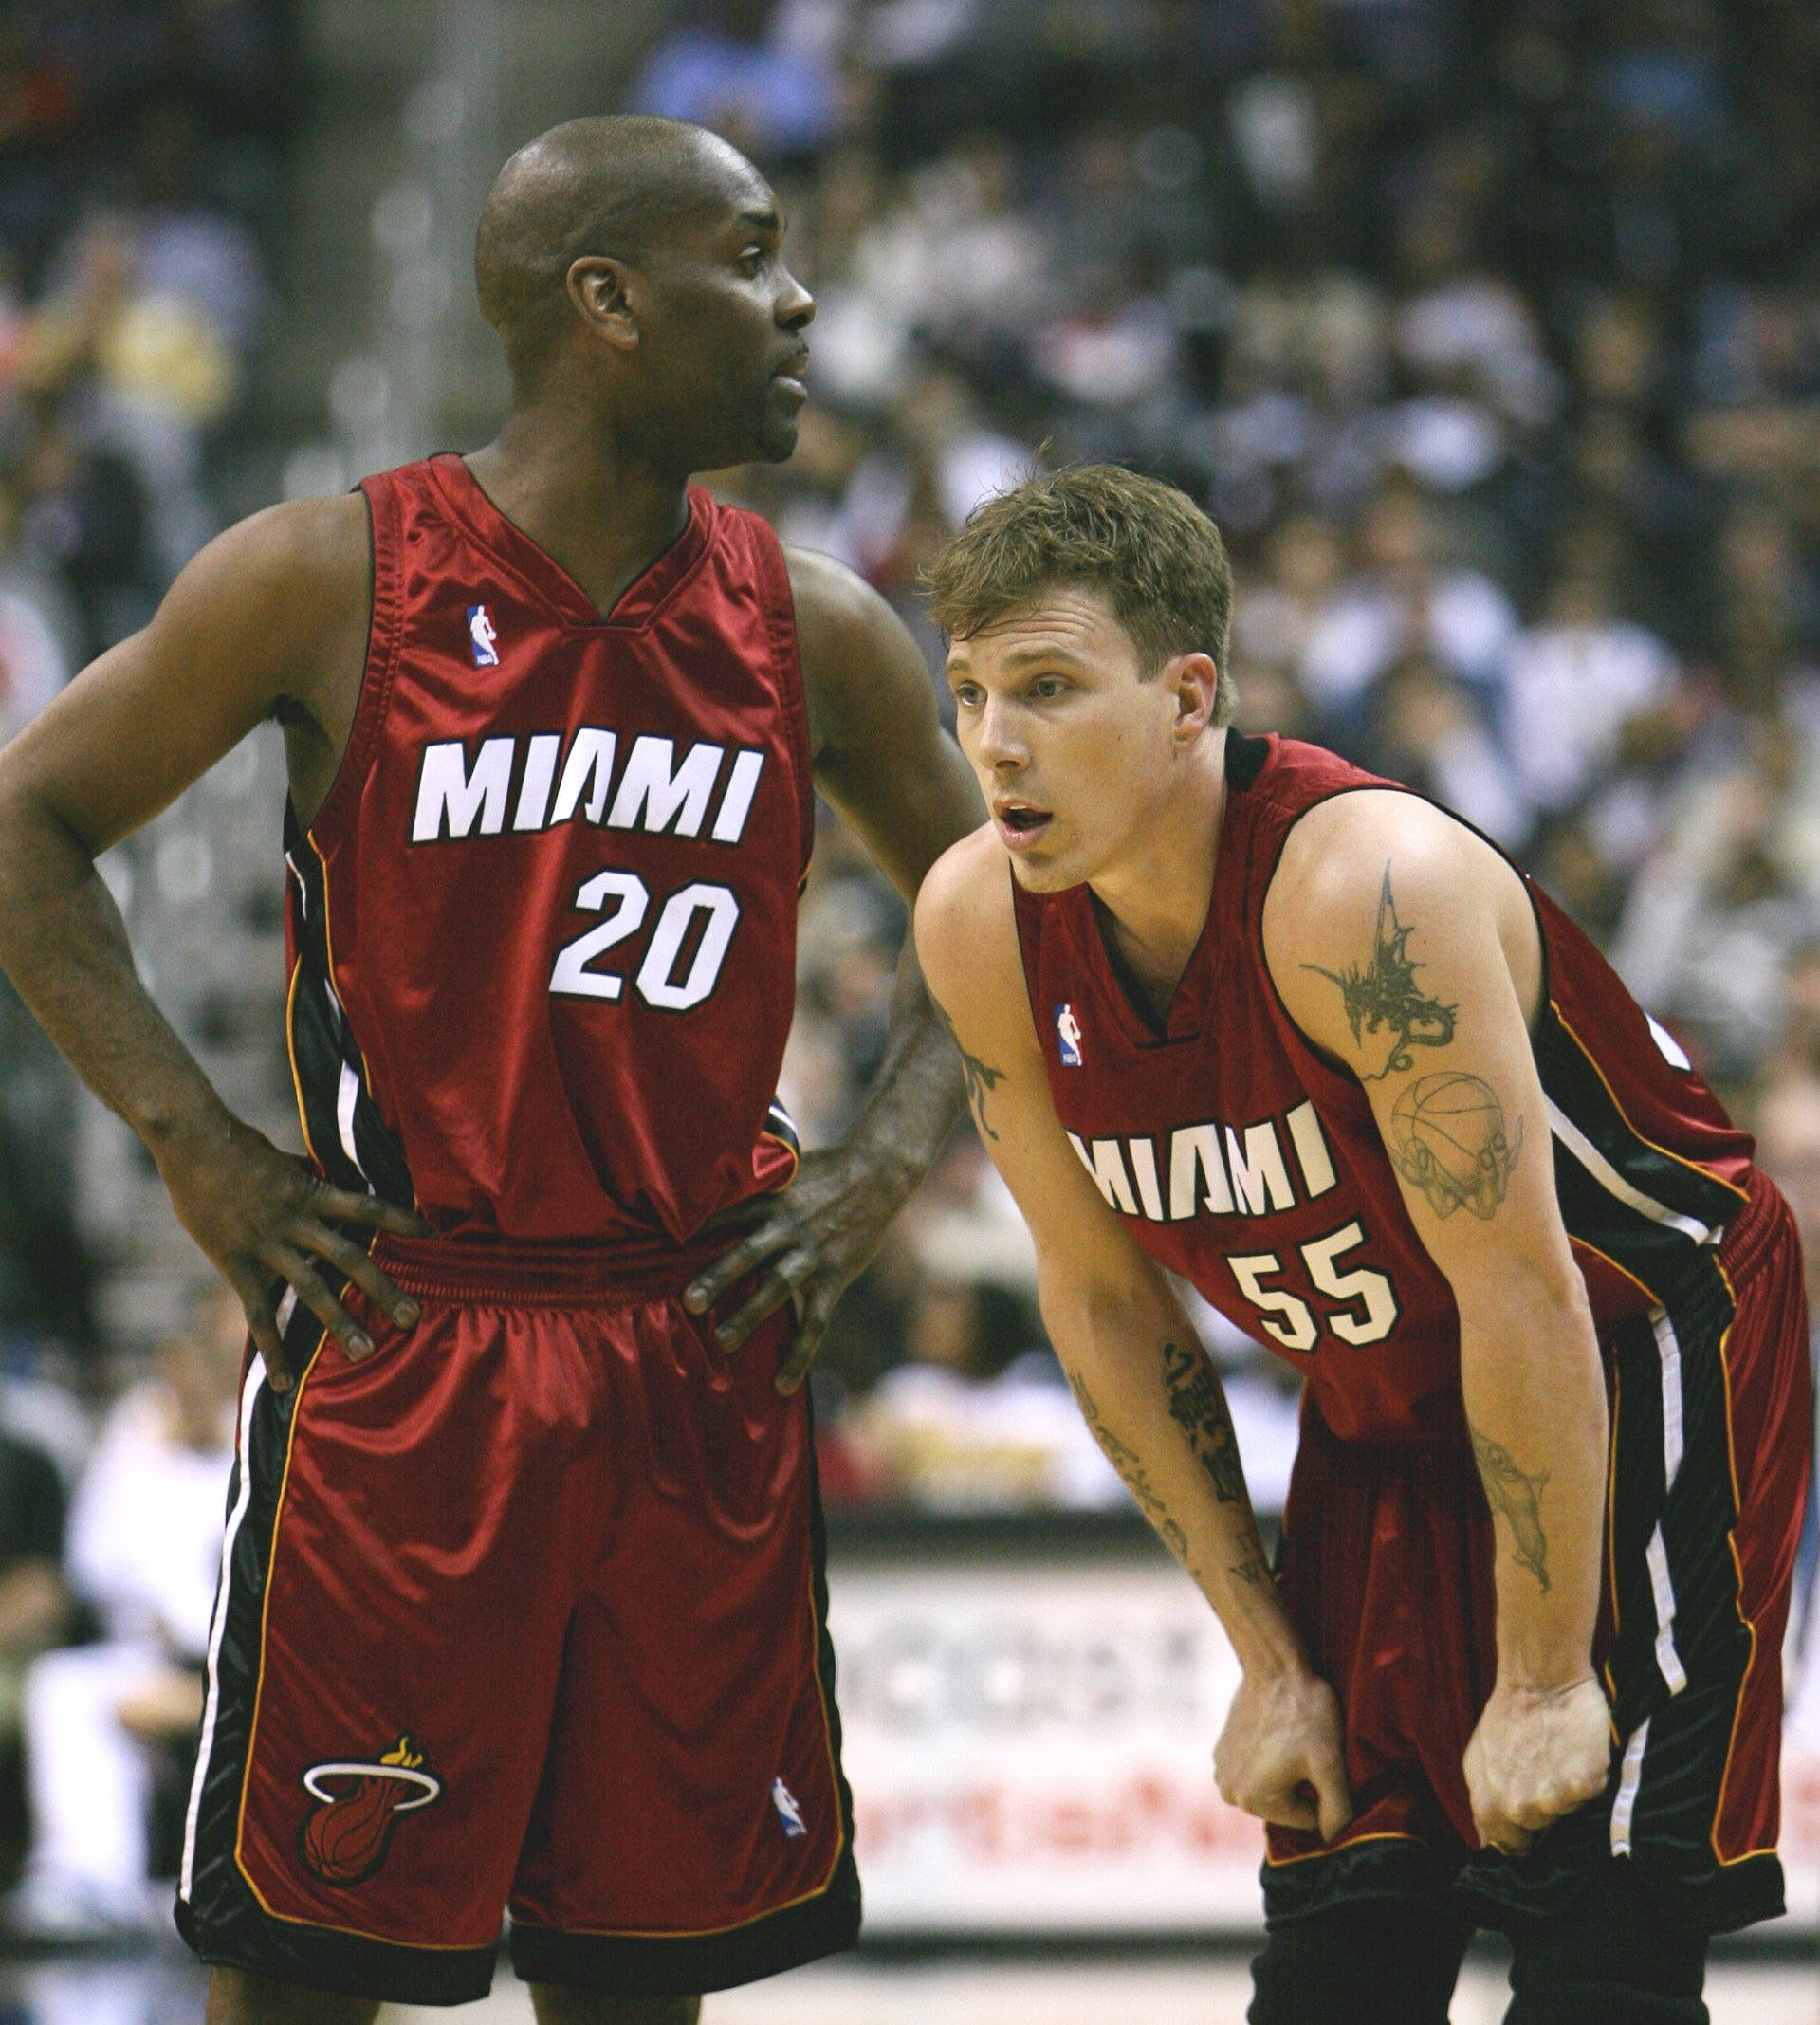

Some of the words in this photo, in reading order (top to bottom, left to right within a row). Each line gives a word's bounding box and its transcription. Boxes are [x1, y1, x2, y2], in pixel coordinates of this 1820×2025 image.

[412, 727, 765, 843] MIAMI
[548, 871, 741, 1011] 20
[1064, 1098, 1338, 1223] MIAMI
[1225, 1220, 1399, 1352] 55
